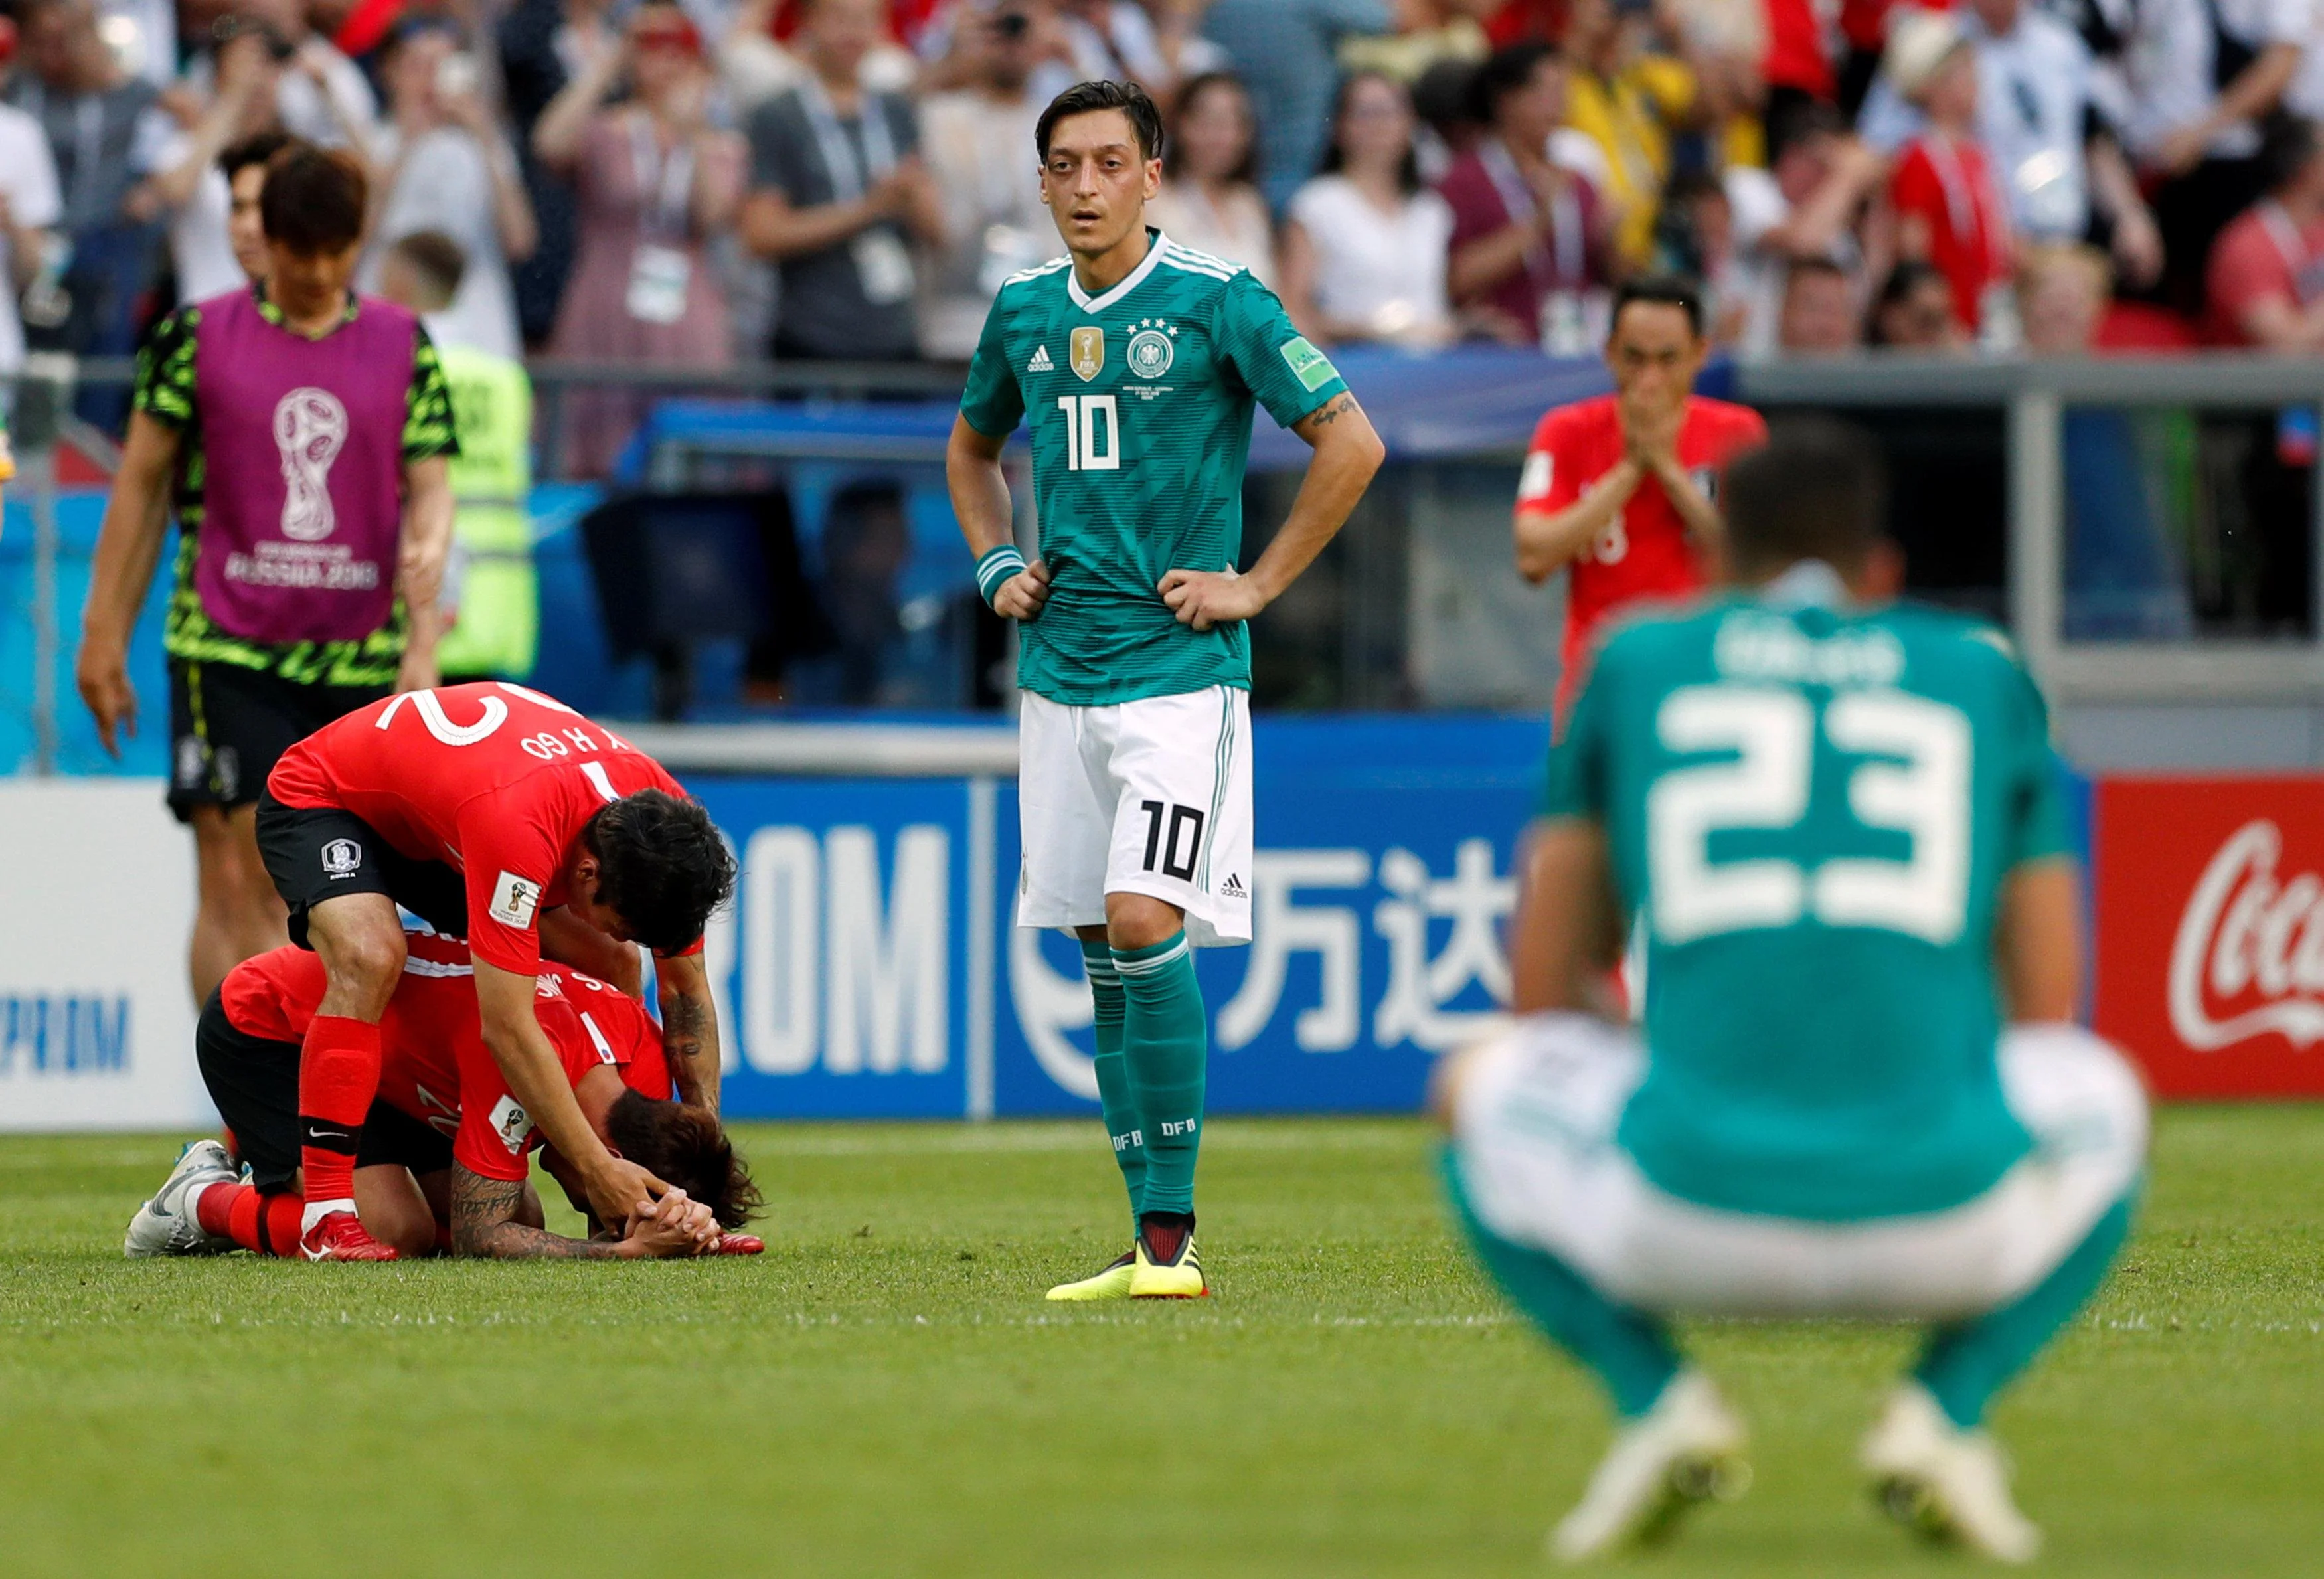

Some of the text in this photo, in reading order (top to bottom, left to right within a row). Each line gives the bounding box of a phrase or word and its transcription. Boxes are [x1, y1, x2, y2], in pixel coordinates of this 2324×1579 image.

[1058, 394, 1120, 471] 10
[521, 732, 569, 760] GO
[1141, 799, 1204, 883] 10
[1647, 683, 1975, 947] 23
[1112, 1129, 1143, 1152] DFB
[1161, 1117, 1196, 1137] DFB
